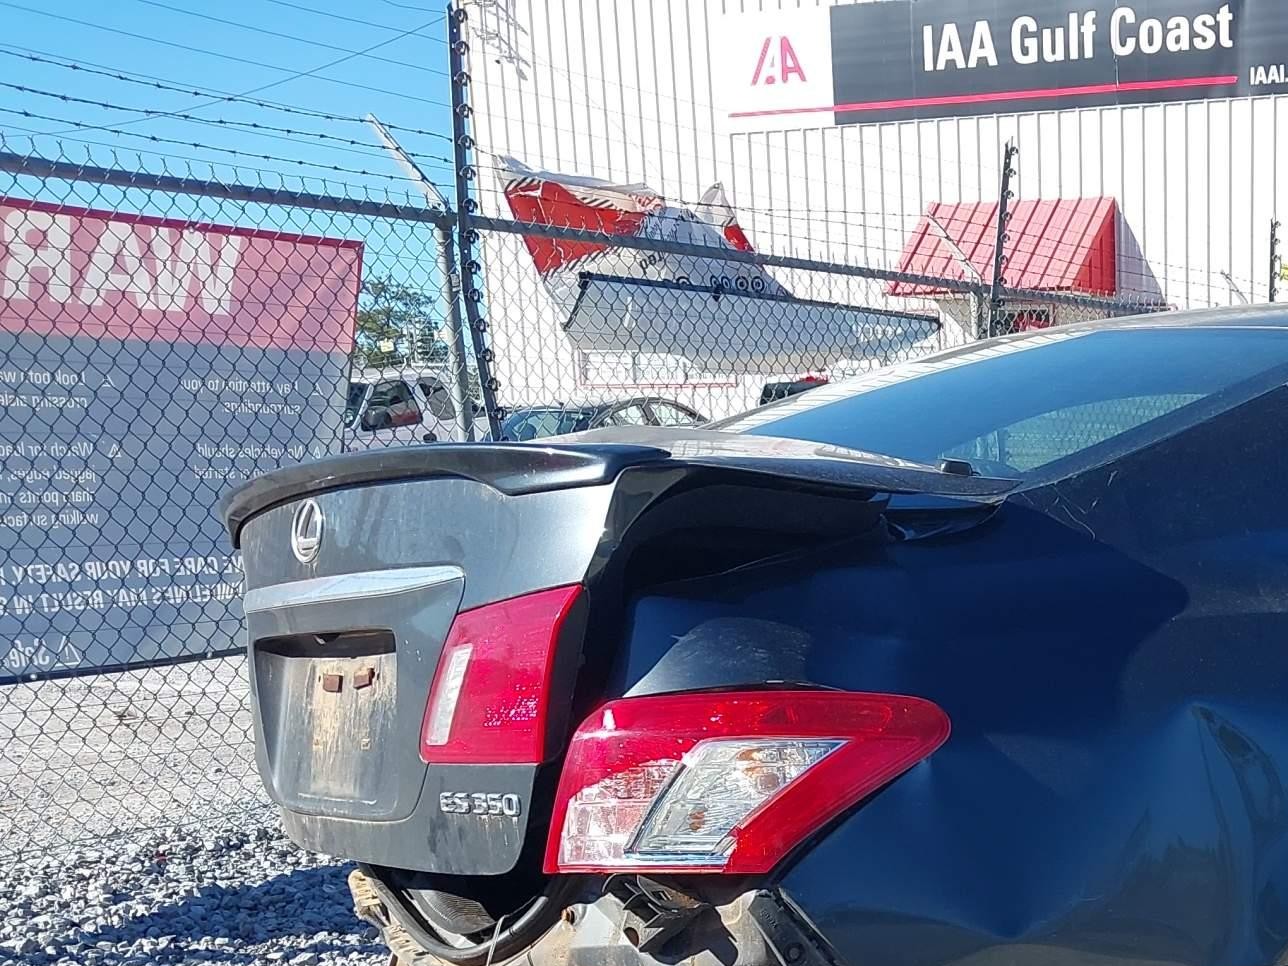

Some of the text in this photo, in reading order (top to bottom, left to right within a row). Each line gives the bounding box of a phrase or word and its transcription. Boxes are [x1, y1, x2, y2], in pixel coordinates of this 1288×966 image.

[922, 4, 1234, 72] IAA Gulf Coast
[440, 791, 521, 816] ES 350
